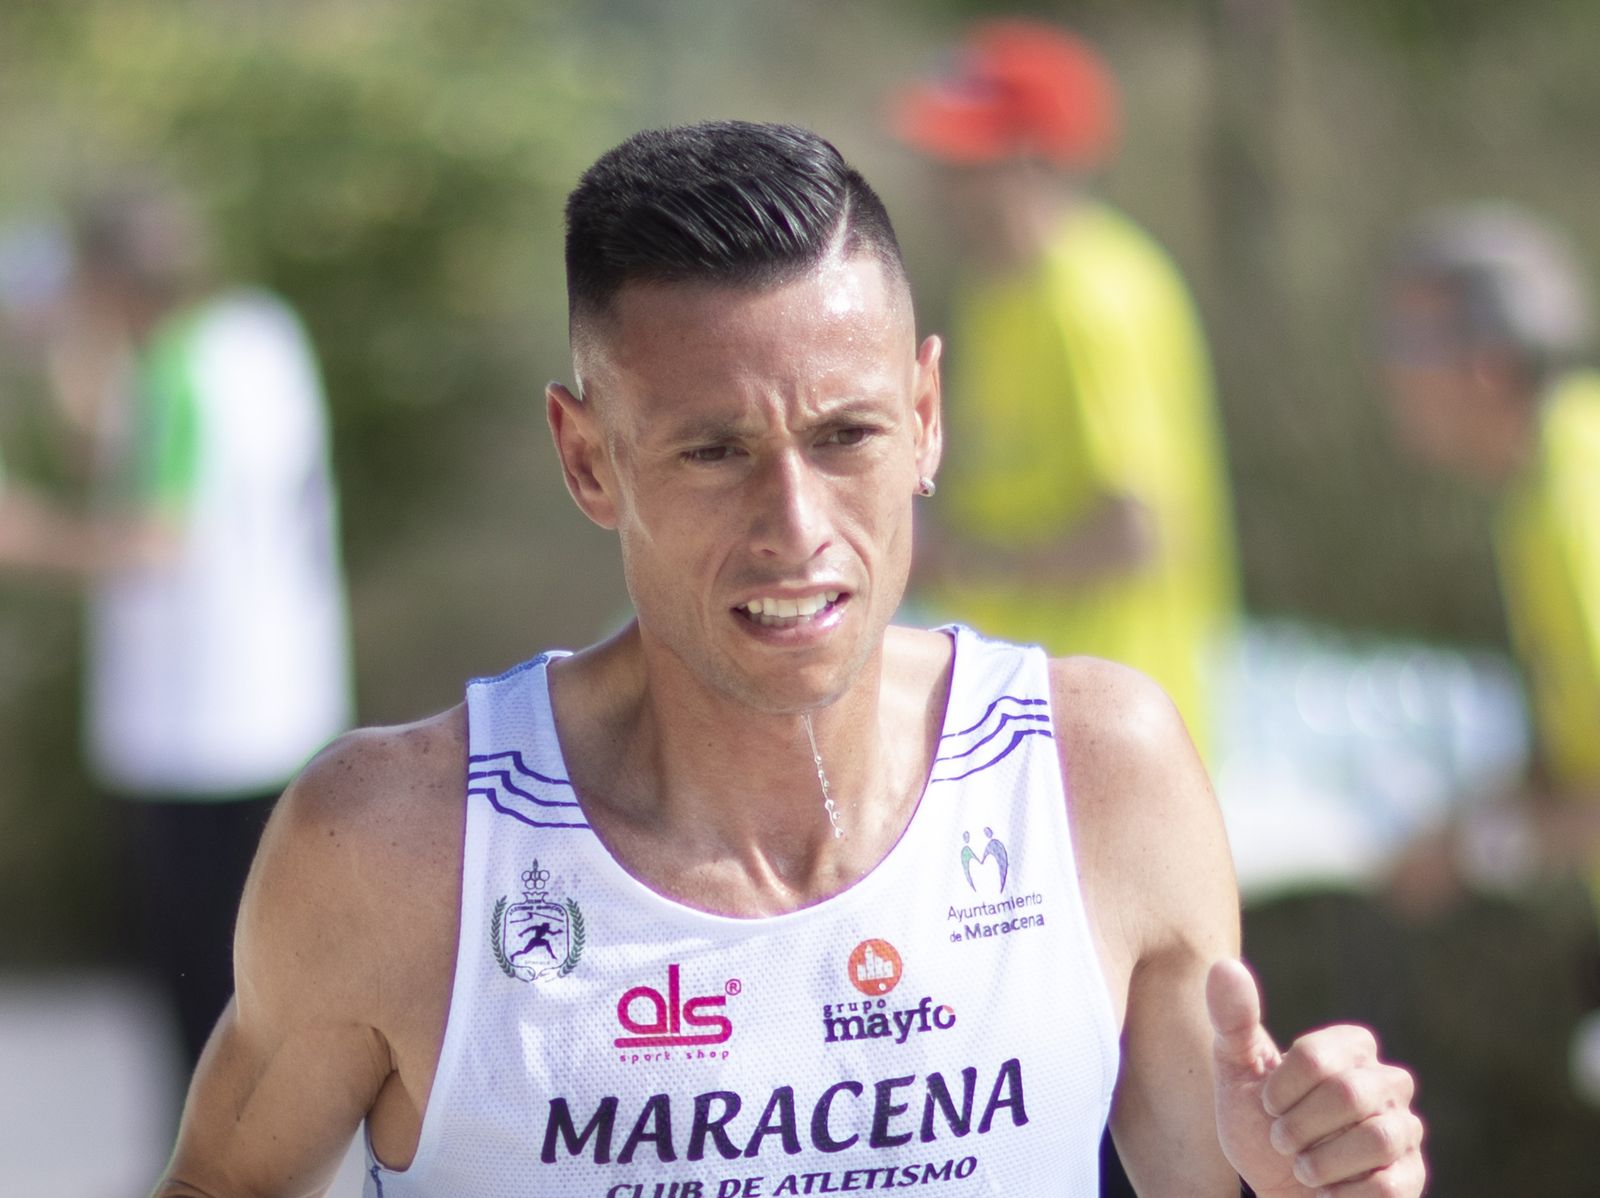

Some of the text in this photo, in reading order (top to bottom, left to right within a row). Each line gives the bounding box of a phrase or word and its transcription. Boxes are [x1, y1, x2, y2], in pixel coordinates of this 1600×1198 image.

[947, 892, 1043, 923] Ayuntamiento
[949, 913, 1045, 943] de Maracena
[823, 998, 887, 1016] grupo
[824, 996, 956, 1044] mayfo
[619, 1048, 730, 1064] sport shop
[540, 1057, 1030, 1165] MARACENA
[773, 1156, 978, 1197] ATLETISMO
